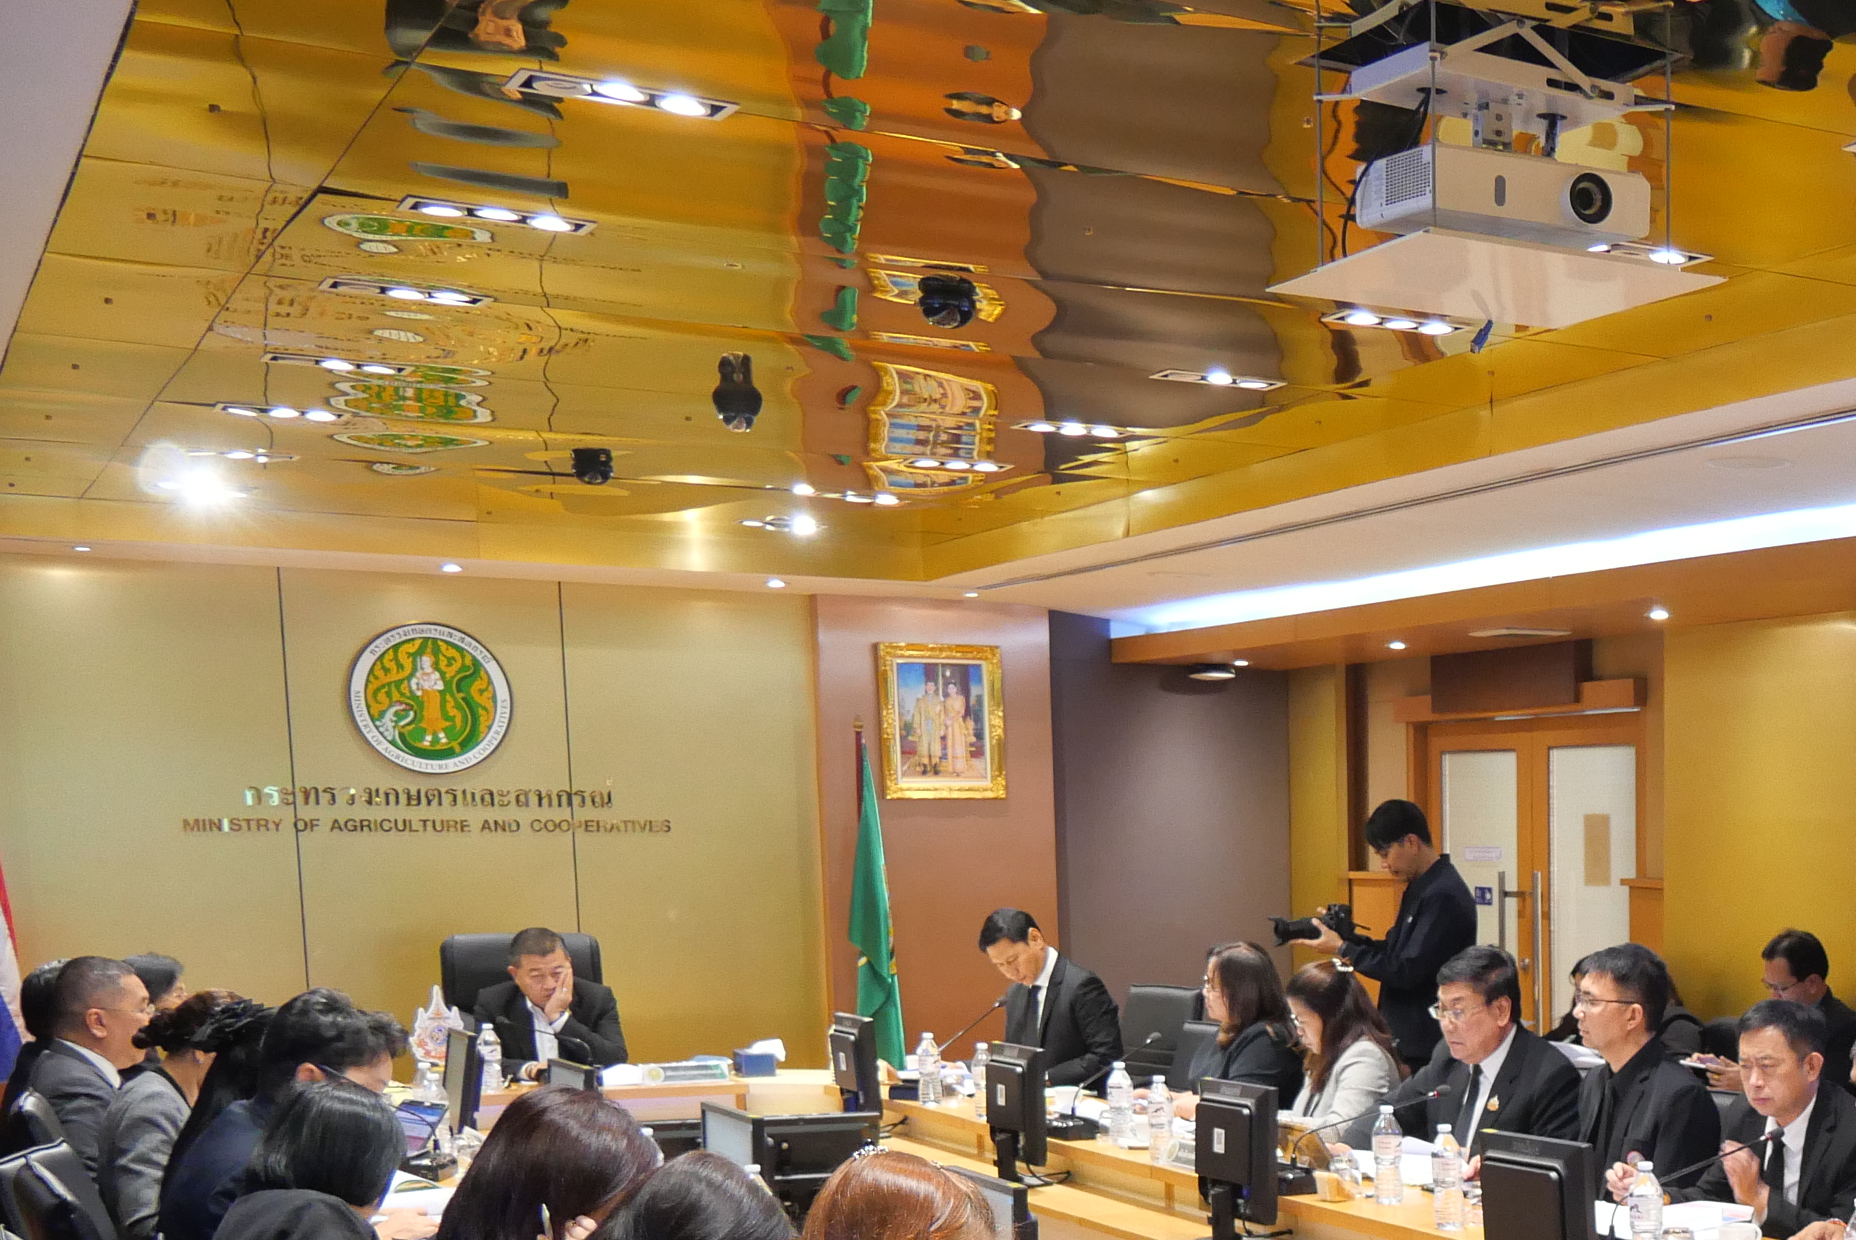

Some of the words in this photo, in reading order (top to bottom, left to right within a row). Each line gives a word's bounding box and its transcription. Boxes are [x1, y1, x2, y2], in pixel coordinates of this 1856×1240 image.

[353, 689, 373, 735] MINISTRY
[370, 732, 383, 748] OF
[383, 746, 449, 772] AGRICULTURE
[452, 756, 475, 769] AND
[473, 698, 508, 761] COOPERATIVES
[242, 777, 614, 809] กระทรวงเกษตรและสหกรณ์
[182, 817, 284, 833] MINISTRY
[293, 817, 321, 833] OF
[329, 818, 472, 834] AGRICULTURE
[480, 818, 521, 834] AND
[530, 818, 672, 834] COOPERATIVES
